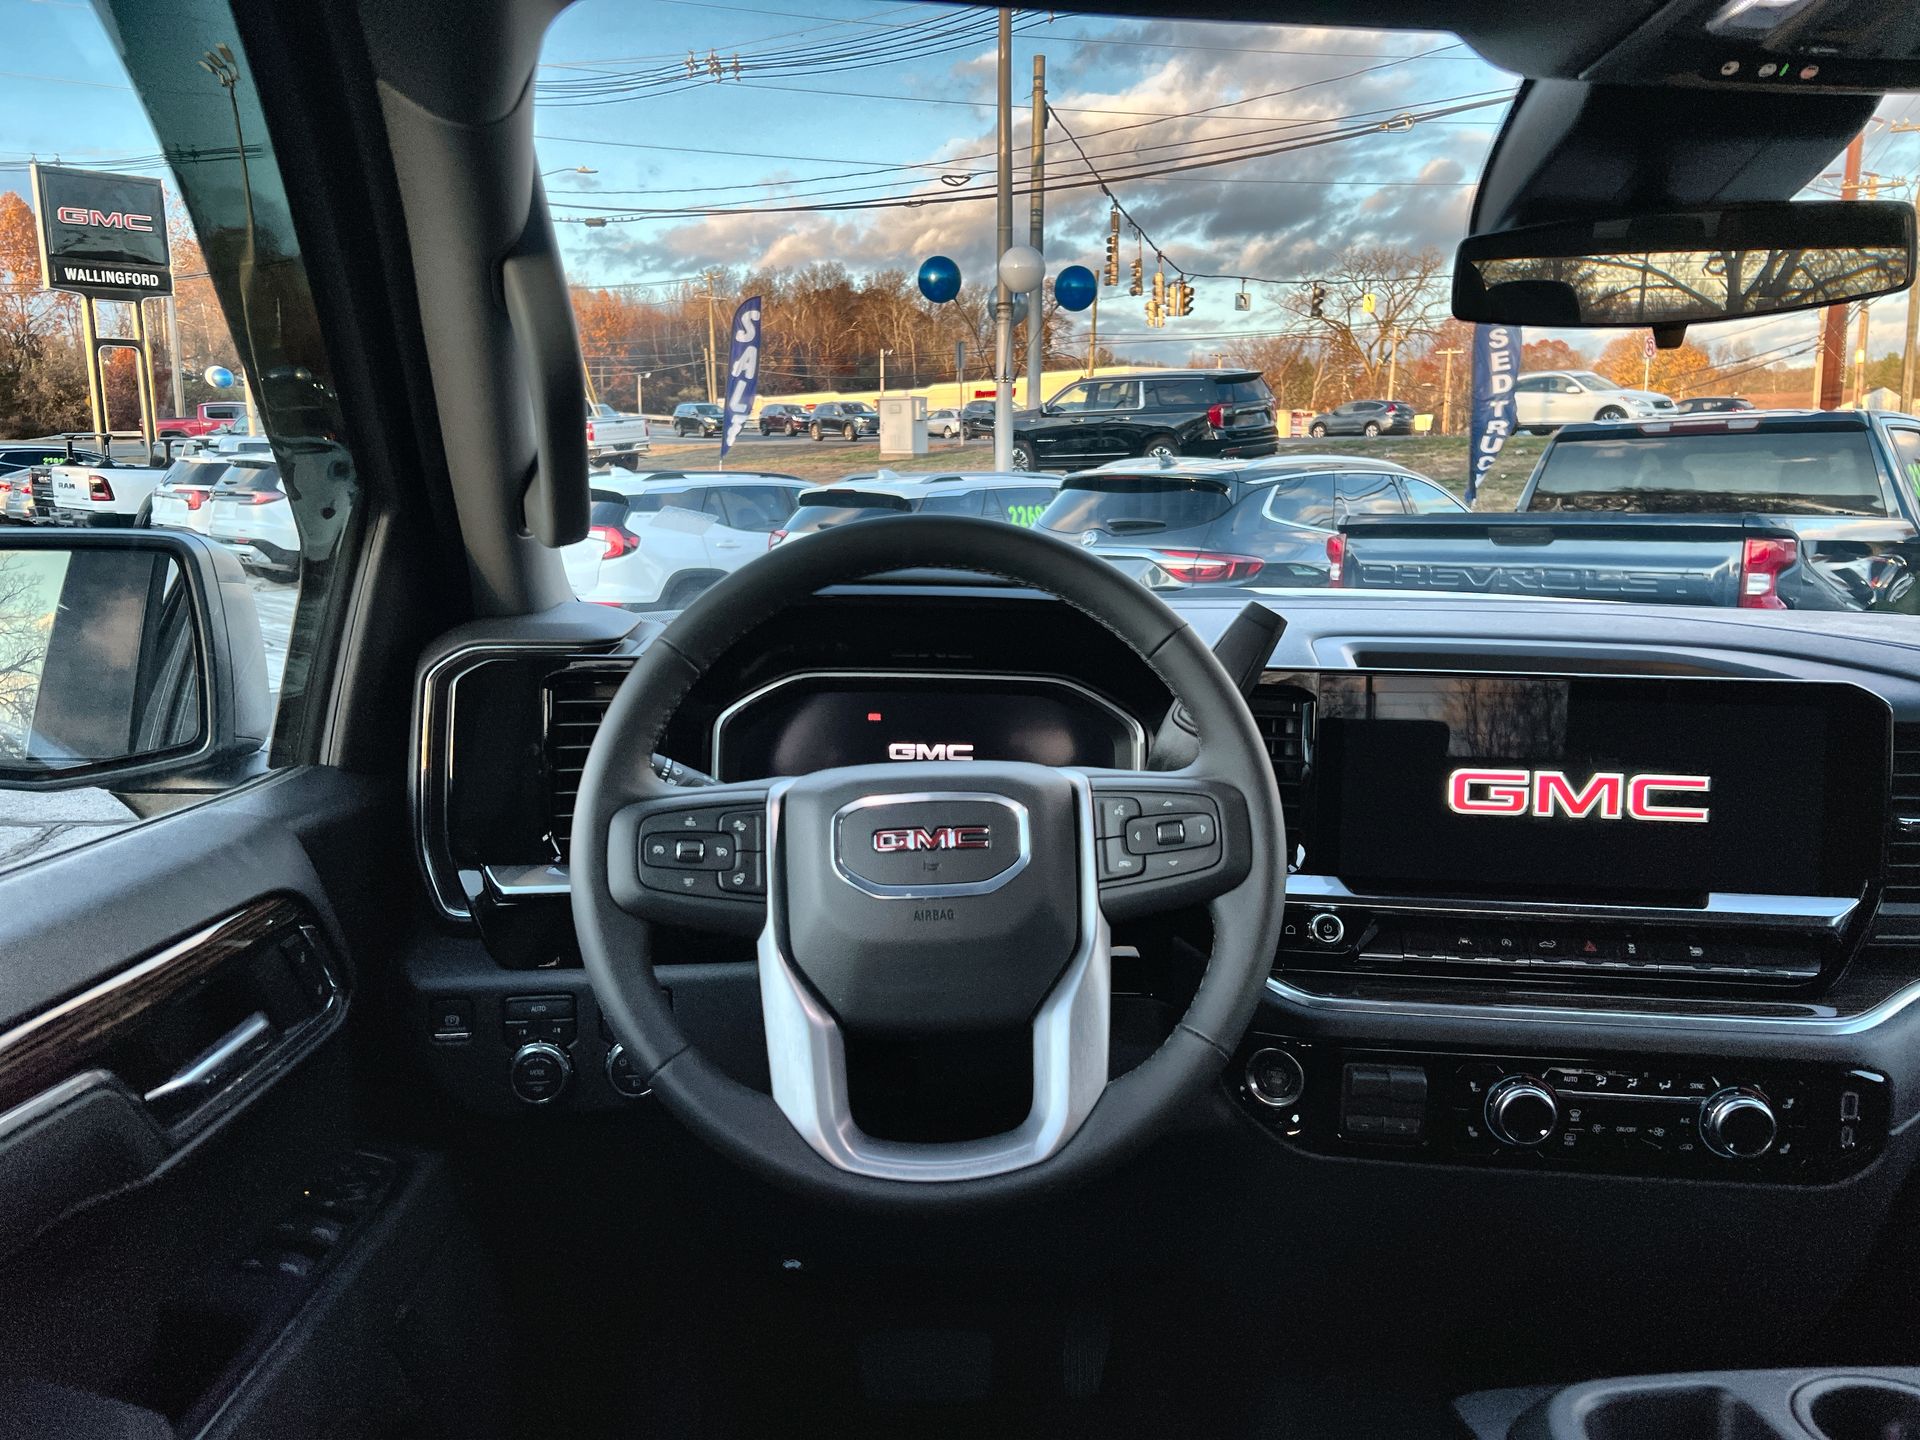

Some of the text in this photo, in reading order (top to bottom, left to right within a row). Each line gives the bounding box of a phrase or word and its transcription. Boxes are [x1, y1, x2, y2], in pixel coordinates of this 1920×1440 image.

[57, 206, 153, 232] GMC
[64, 267, 159, 287] WALLINGFORD
[1488, 323, 1513, 395] SED
[1362, 563, 1704, 595] CHEVROLET
[888, 743, 974, 761] GMC
[1448, 768, 1711, 823] GMC
[873, 826, 991, 852] GMC
[914, 909, 954, 921] AIRBAG
[1564, 1075, 1578, 1083] AUTO
[1689, 1082, 1705, 1090] SYNC
